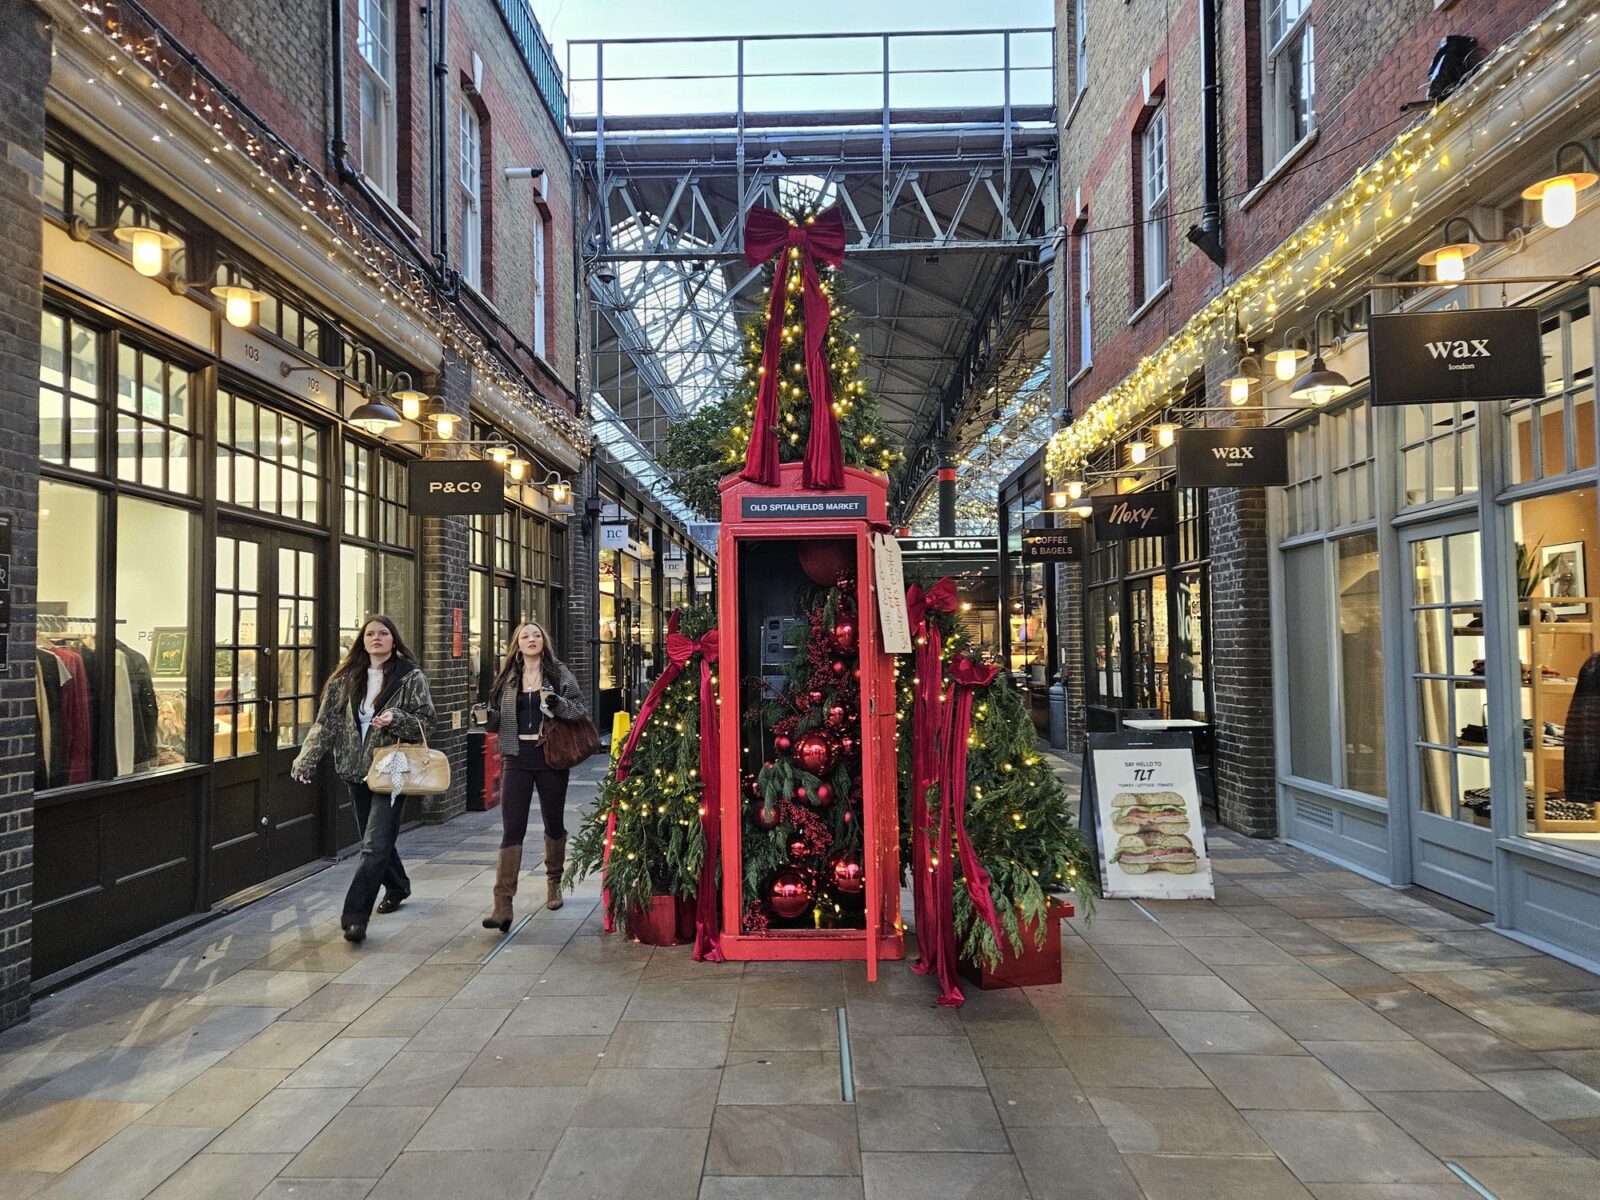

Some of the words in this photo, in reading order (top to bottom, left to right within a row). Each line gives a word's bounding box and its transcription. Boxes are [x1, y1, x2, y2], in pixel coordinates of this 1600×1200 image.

[244, 344, 259, 361] 103
[1424, 338, 1491, 359] wax
[1448, 363, 1475, 371] london
[1211, 446, 1254, 459] wax
[750, 504, 768, 512] OLD
[769, 503, 824, 511] SPITALFIELDS
[825, 502, 859, 510] MARKET
[606, 529, 623, 539] nc
[1035, 536, 1069, 545] COFFEE
[1040, 546, 1073, 555] BAGELS
[1133, 769, 1155, 781] TLT
